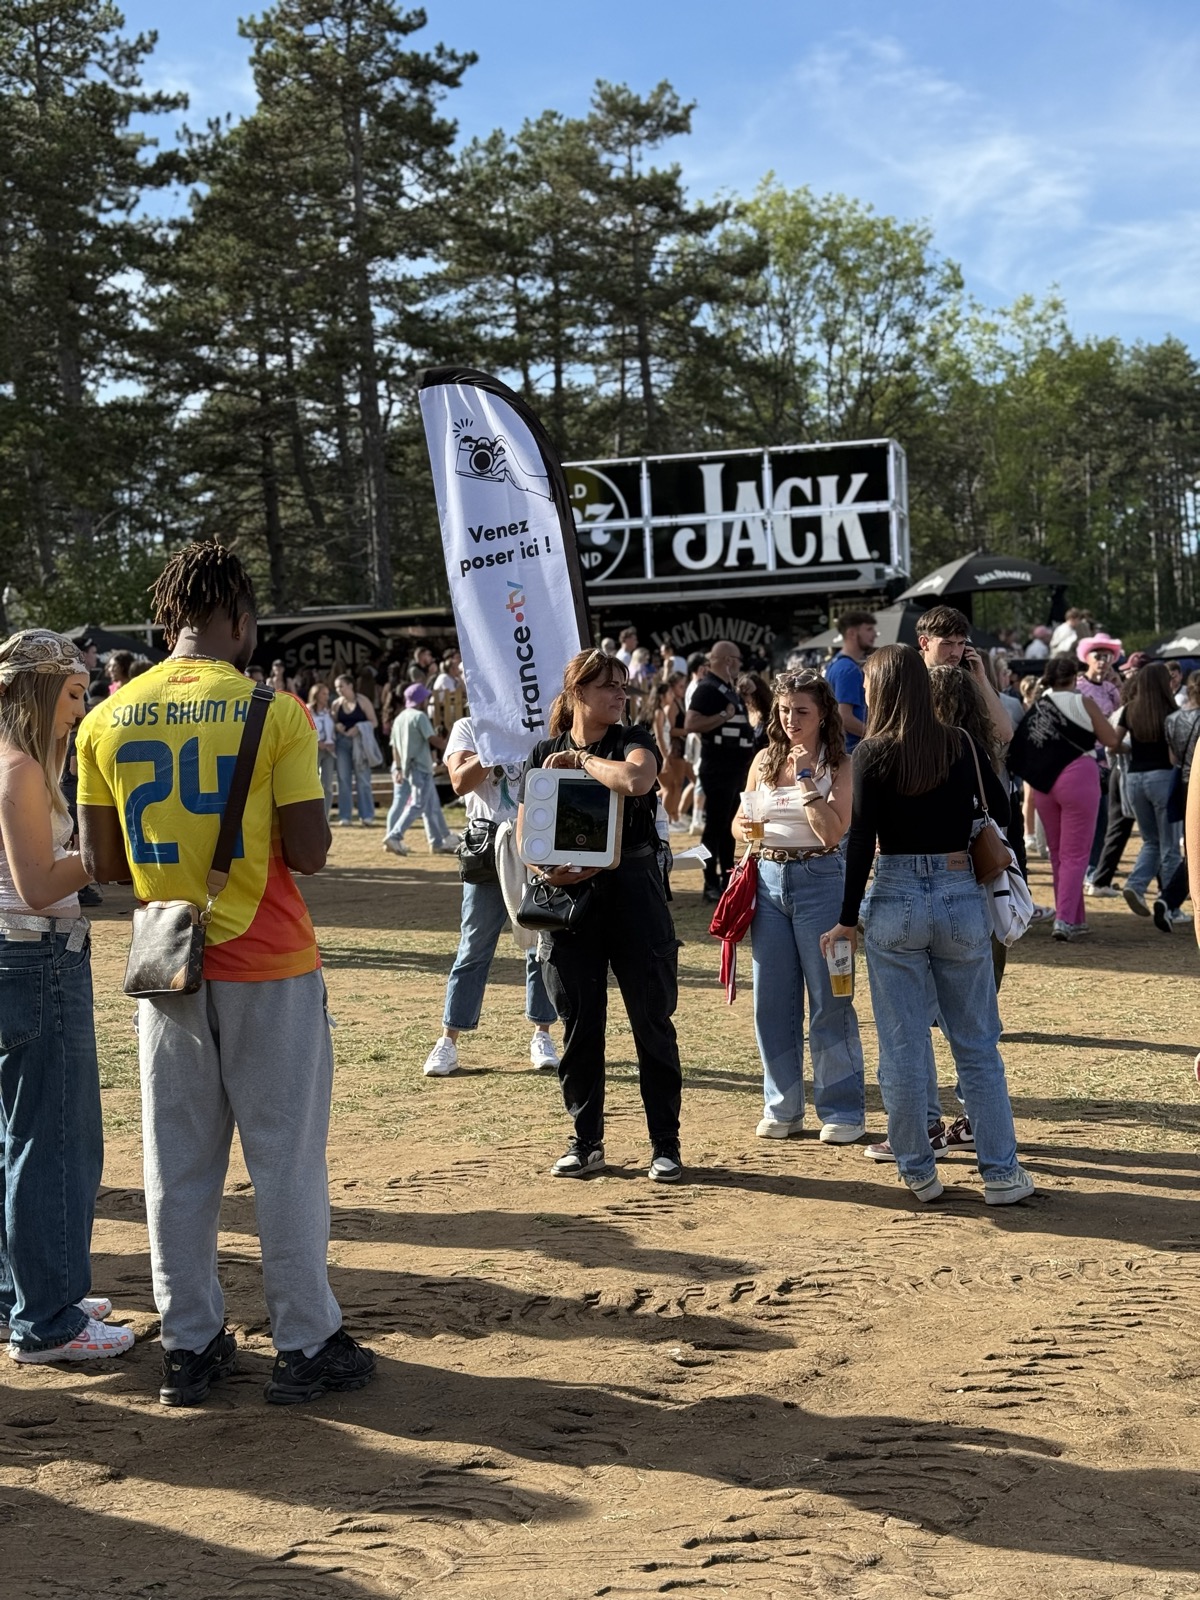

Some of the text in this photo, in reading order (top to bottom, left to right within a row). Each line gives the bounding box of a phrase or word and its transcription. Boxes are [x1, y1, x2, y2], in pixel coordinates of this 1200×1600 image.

[468, 520, 529, 543] Venez
[672, 463, 872, 570] JACK
[460, 549, 514, 577] poser
[520, 538, 540, 559] ici
[111, 702, 159, 728] SOUS
[166, 700, 227, 725] RHUM
[116, 736, 245, 864] 24
